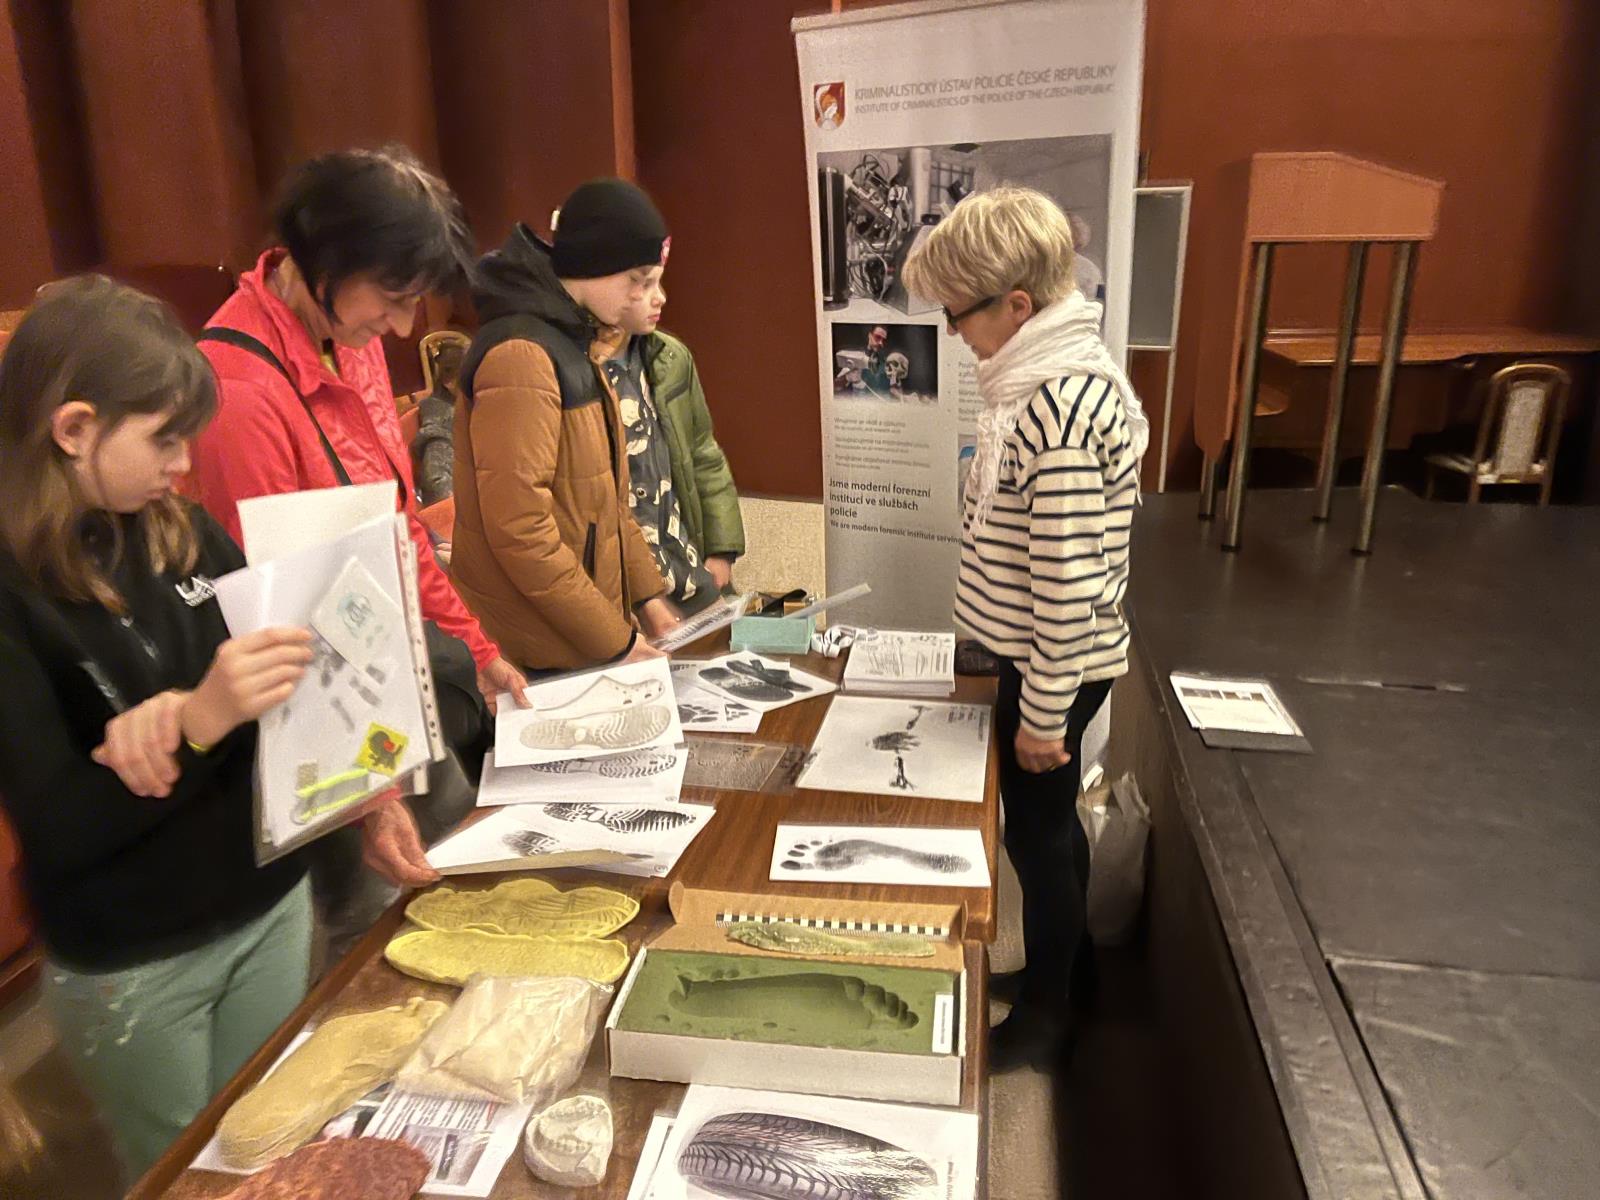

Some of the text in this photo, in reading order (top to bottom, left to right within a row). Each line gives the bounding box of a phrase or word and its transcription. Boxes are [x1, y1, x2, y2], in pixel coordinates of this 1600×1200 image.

[974, 74, 1015, 89] POLICIE
[1017, 68, 1051, 86] ČESKÉ
[1054, 65, 1117, 81] REPUBLIKY
[829, 478, 931, 498] Jsme moderní forenzní
[830, 507, 857, 518] policie
[865, 498, 876, 506] ve
[878, 498, 918, 511] službách
[840, 522, 850, 530] are
[851, 523, 879, 533] modern
[879, 526, 906, 537] forensic
[907, 530, 935, 540] institute
